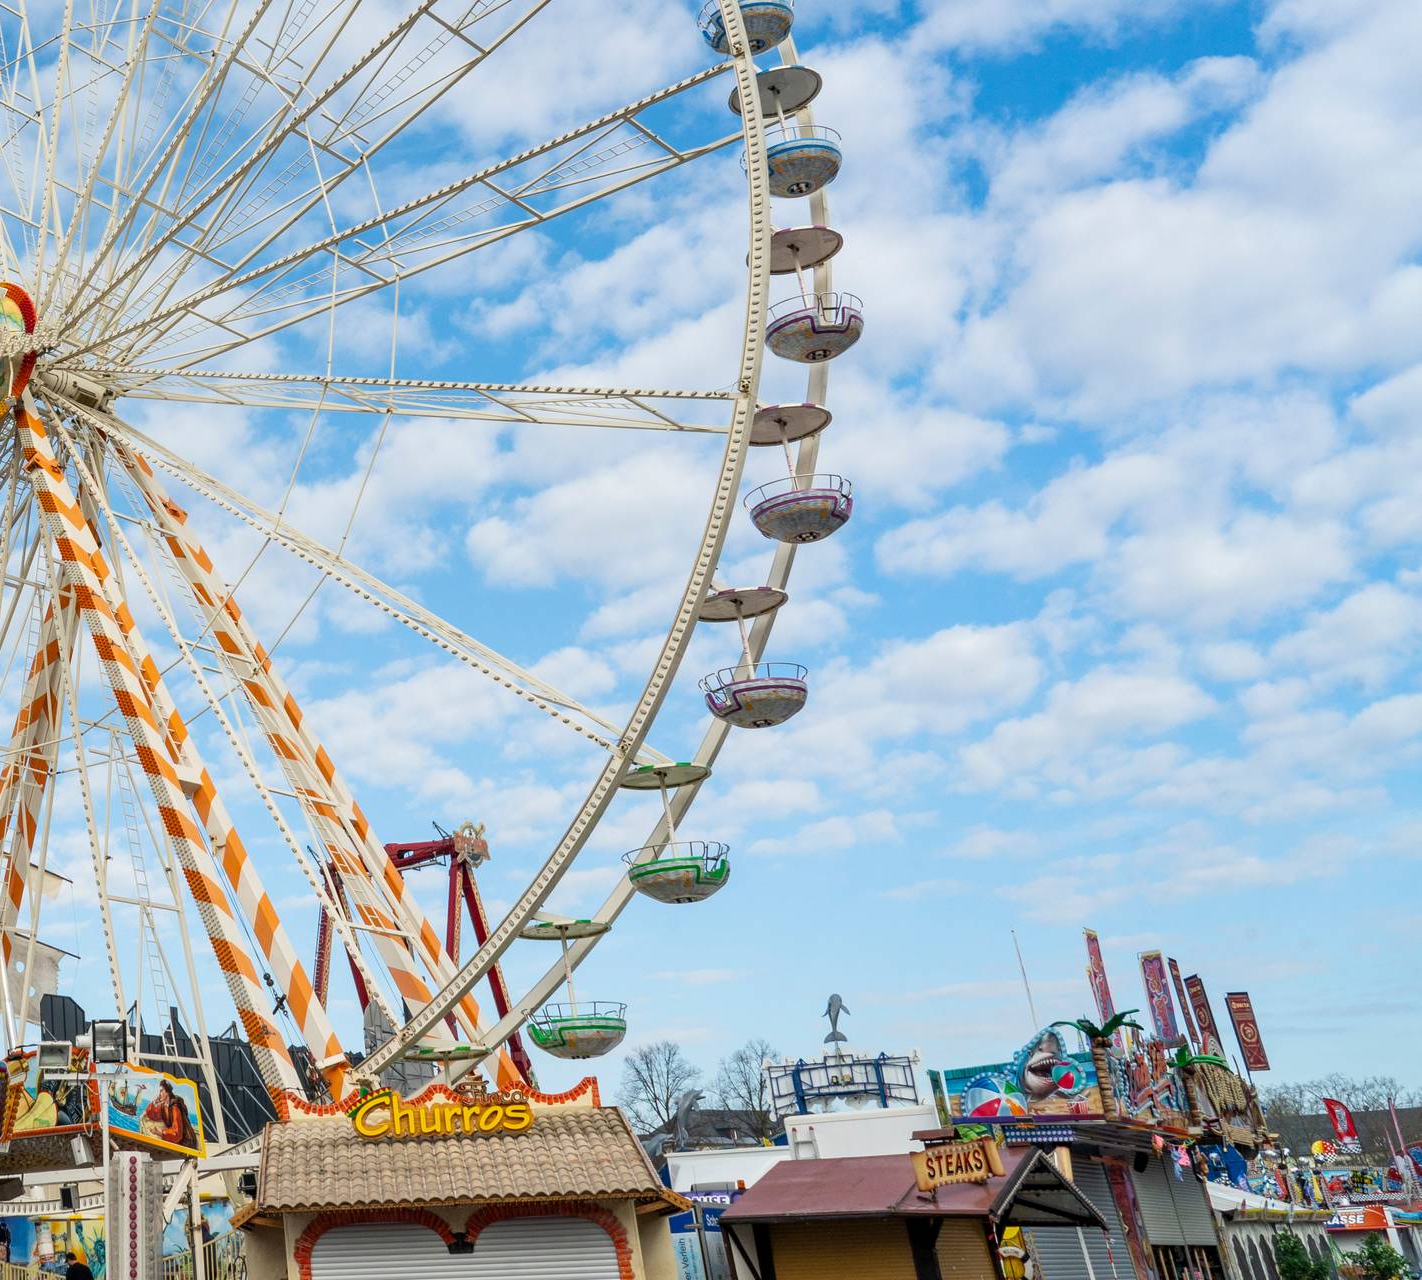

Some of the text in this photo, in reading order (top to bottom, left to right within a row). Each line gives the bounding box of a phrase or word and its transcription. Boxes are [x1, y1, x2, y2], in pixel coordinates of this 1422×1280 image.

[354, 1094, 531, 1138] Churros
[925, 1149, 984, 1179] STEAKS
[678, 1238, 690, 1270] Verleih
